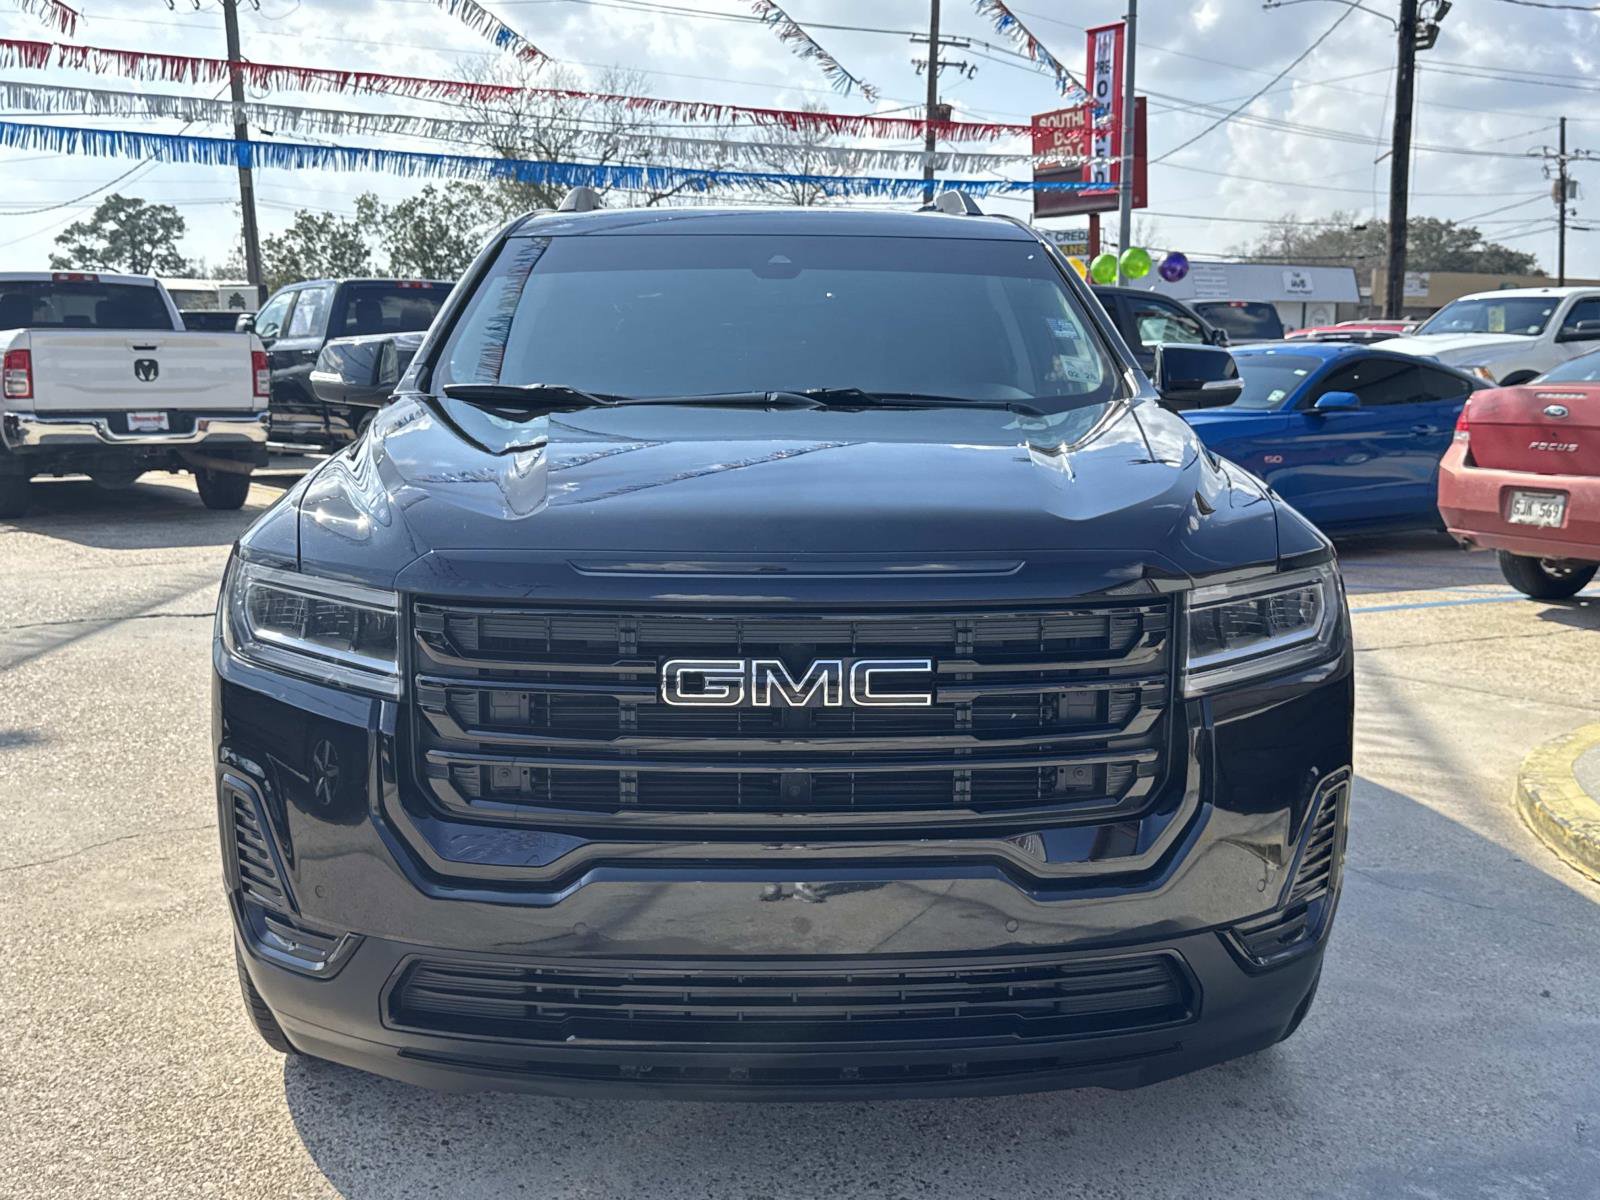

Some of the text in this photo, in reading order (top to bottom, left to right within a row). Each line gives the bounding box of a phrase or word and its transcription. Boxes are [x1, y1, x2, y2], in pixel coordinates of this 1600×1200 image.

[1528, 441, 1579, 453] FOCUS
[1539, 502, 1560, 519] 569
[661, 659, 933, 707] GMC
